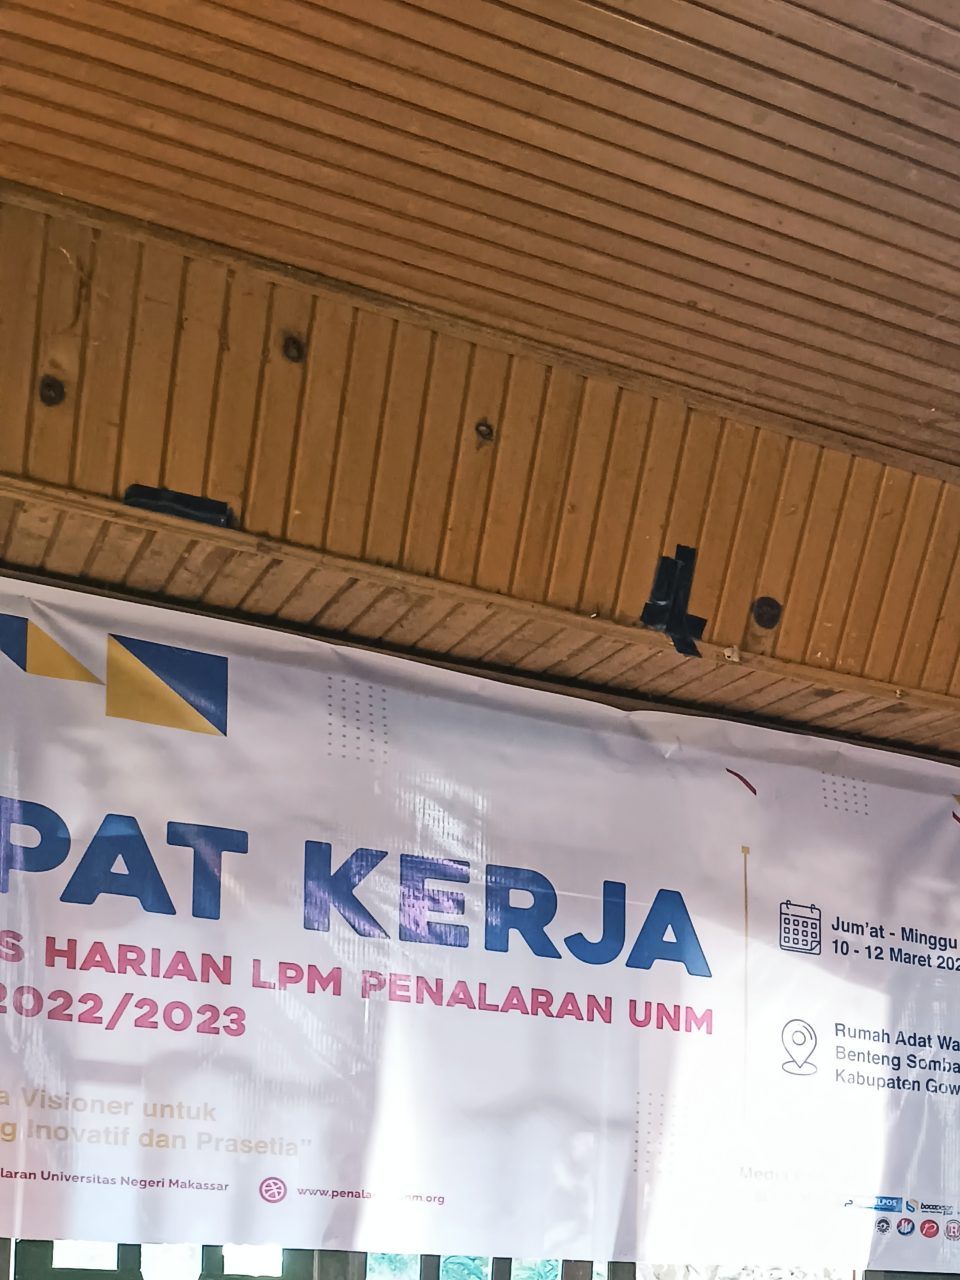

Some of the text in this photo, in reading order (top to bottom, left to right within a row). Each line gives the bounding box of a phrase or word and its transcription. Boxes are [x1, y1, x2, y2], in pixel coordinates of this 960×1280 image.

[303, 840, 712, 977] KERJA
[901, 927, 958, 951] Minggu
[832, 940, 849, 956] 10
[865, 945, 884, 960] 12
[890, 947, 932, 968] Maret
[45, 936, 232, 985] HARIAN
[252, 959, 342, 996] LPM
[362, 970, 613, 1023] PENALARAN
[629, 999, 713, 1034] UNM
[834, 1023, 890, 1044] Rumah
[895, 1031, 932, 1049] Adat
[836, 1046, 901, 1070] Benteng
[906, 1054, 960, 1074] Somba
[835, 1069, 920, 1092] Kabupaten
[22, 1087, 133, 1115] Visioner
[143, 1100, 216, 1122] untuk
[27, 1118, 129, 1147] Inovatif
[139, 1129, 186, 1150] dan
[41, 1170, 116, 1186] Universitas
[121, 1176, 165, 1189] Negeri
[168, 1179, 230, 1191] Makassar
